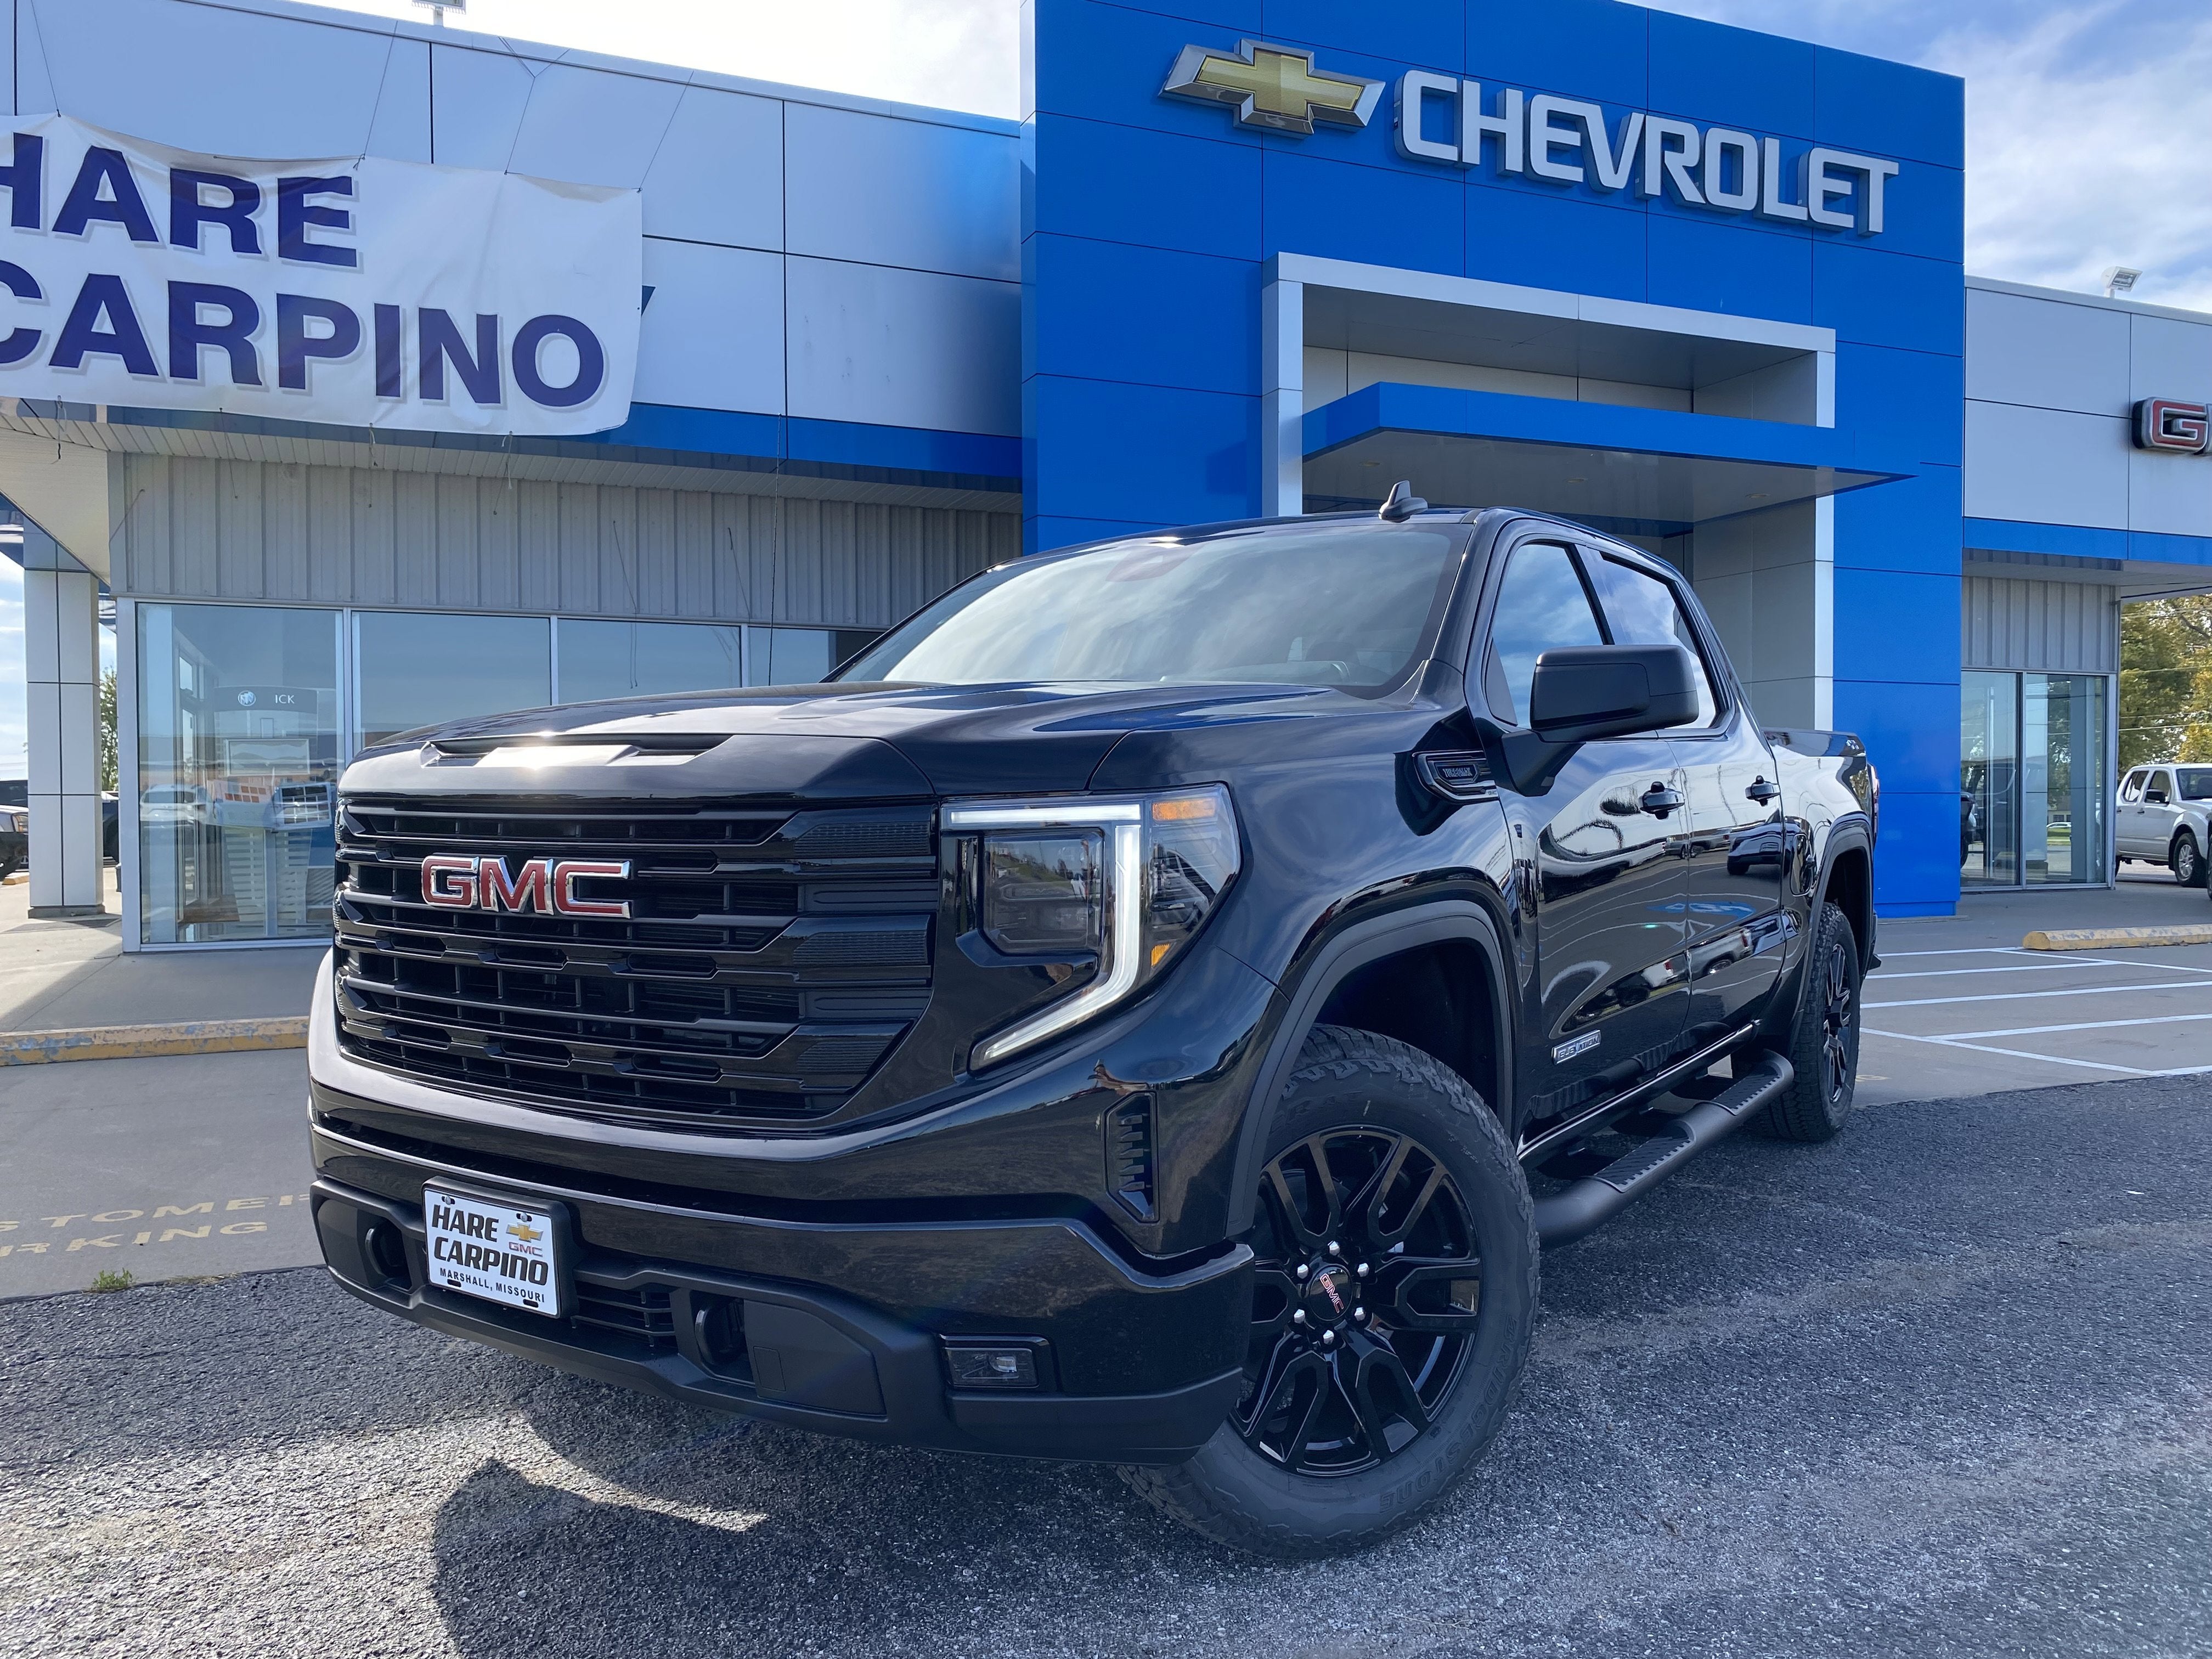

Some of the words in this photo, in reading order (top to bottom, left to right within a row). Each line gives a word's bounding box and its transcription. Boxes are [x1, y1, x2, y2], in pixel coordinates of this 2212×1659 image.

[1396, 68, 1899, 236] CHEVROLET
[421, 855, 630, 919] GMC
[432, 1204, 499, 1242] HARE
[434, 1236, 549, 1286] CARPINO
[508, 1242, 543, 1257] GMC
[440, 1267, 493, 1291] MARSHALL,
[496, 1282, 545, 1302] MISSOURI
[1319, 1273, 1344, 1313] GMC
